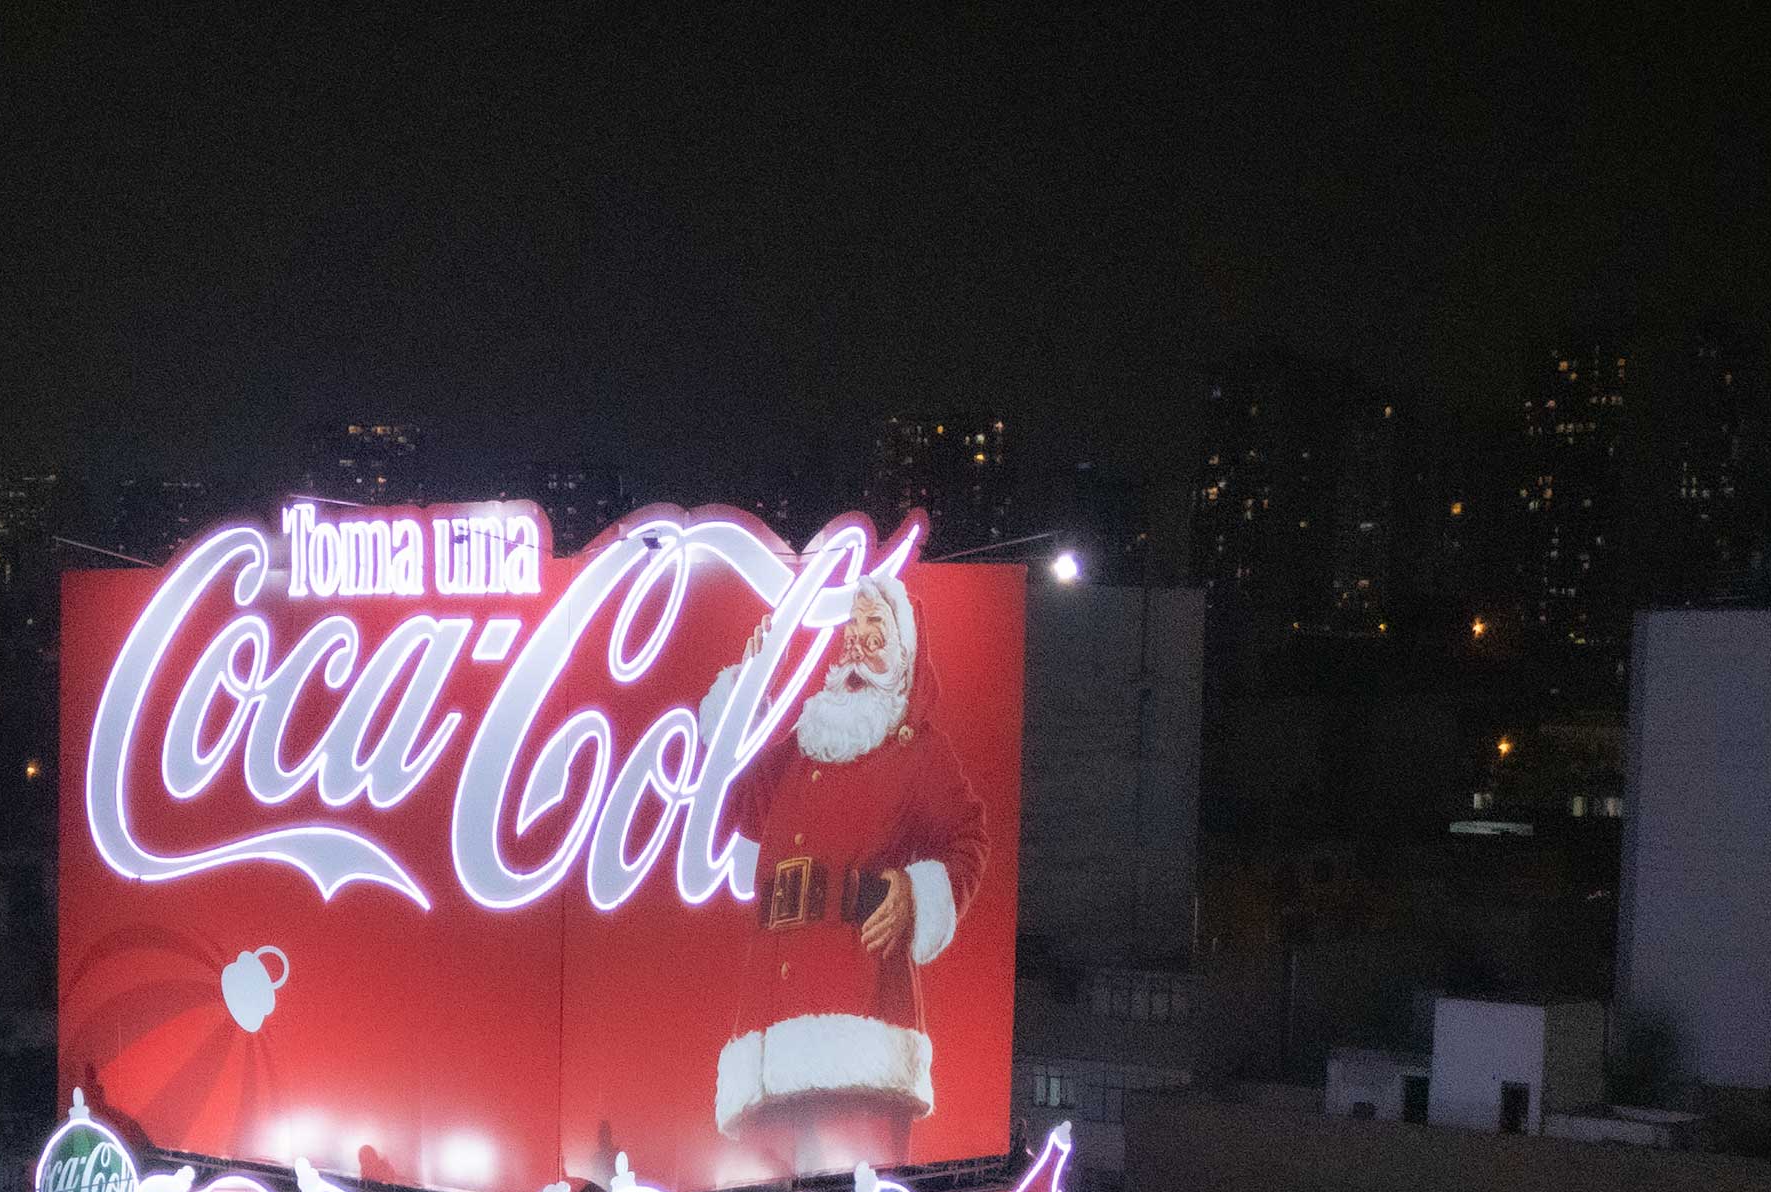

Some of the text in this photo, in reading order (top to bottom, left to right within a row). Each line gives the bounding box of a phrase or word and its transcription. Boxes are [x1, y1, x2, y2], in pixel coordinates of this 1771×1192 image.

[282, 503, 541, 596] Toma una
[86, 520, 922, 910] Coca-Col
